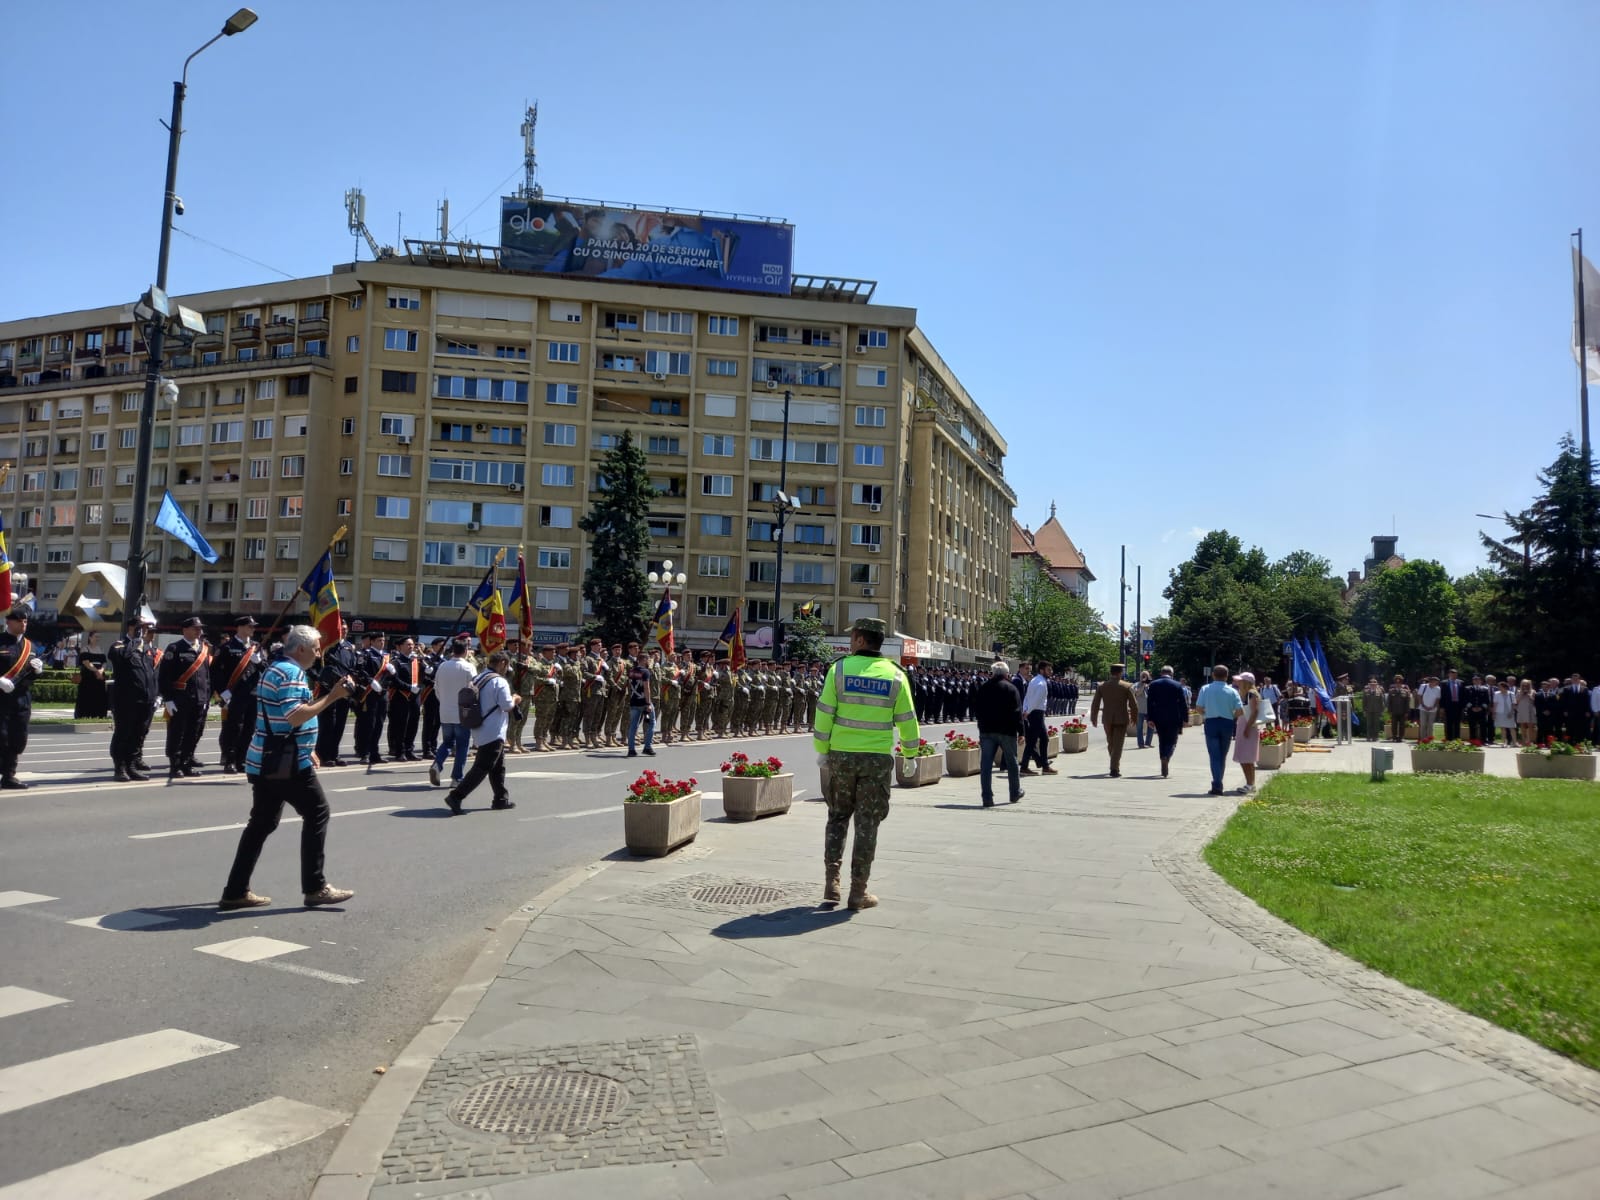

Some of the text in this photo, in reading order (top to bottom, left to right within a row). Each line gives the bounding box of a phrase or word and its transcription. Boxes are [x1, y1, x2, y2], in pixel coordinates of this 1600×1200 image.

[510, 207, 545, 235] glo
[573, 247, 590, 257] CU
[591, 248, 601, 258] O
[603, 250, 653, 263] SINGURĂ
[620, 241, 634, 250] LA
[636, 243, 649, 252] 20
[651, 244, 666, 254] DE
[667, 246, 711, 258] SESIUNI
[764, 265, 782, 274] NOU
[764, 275, 783, 286] air
